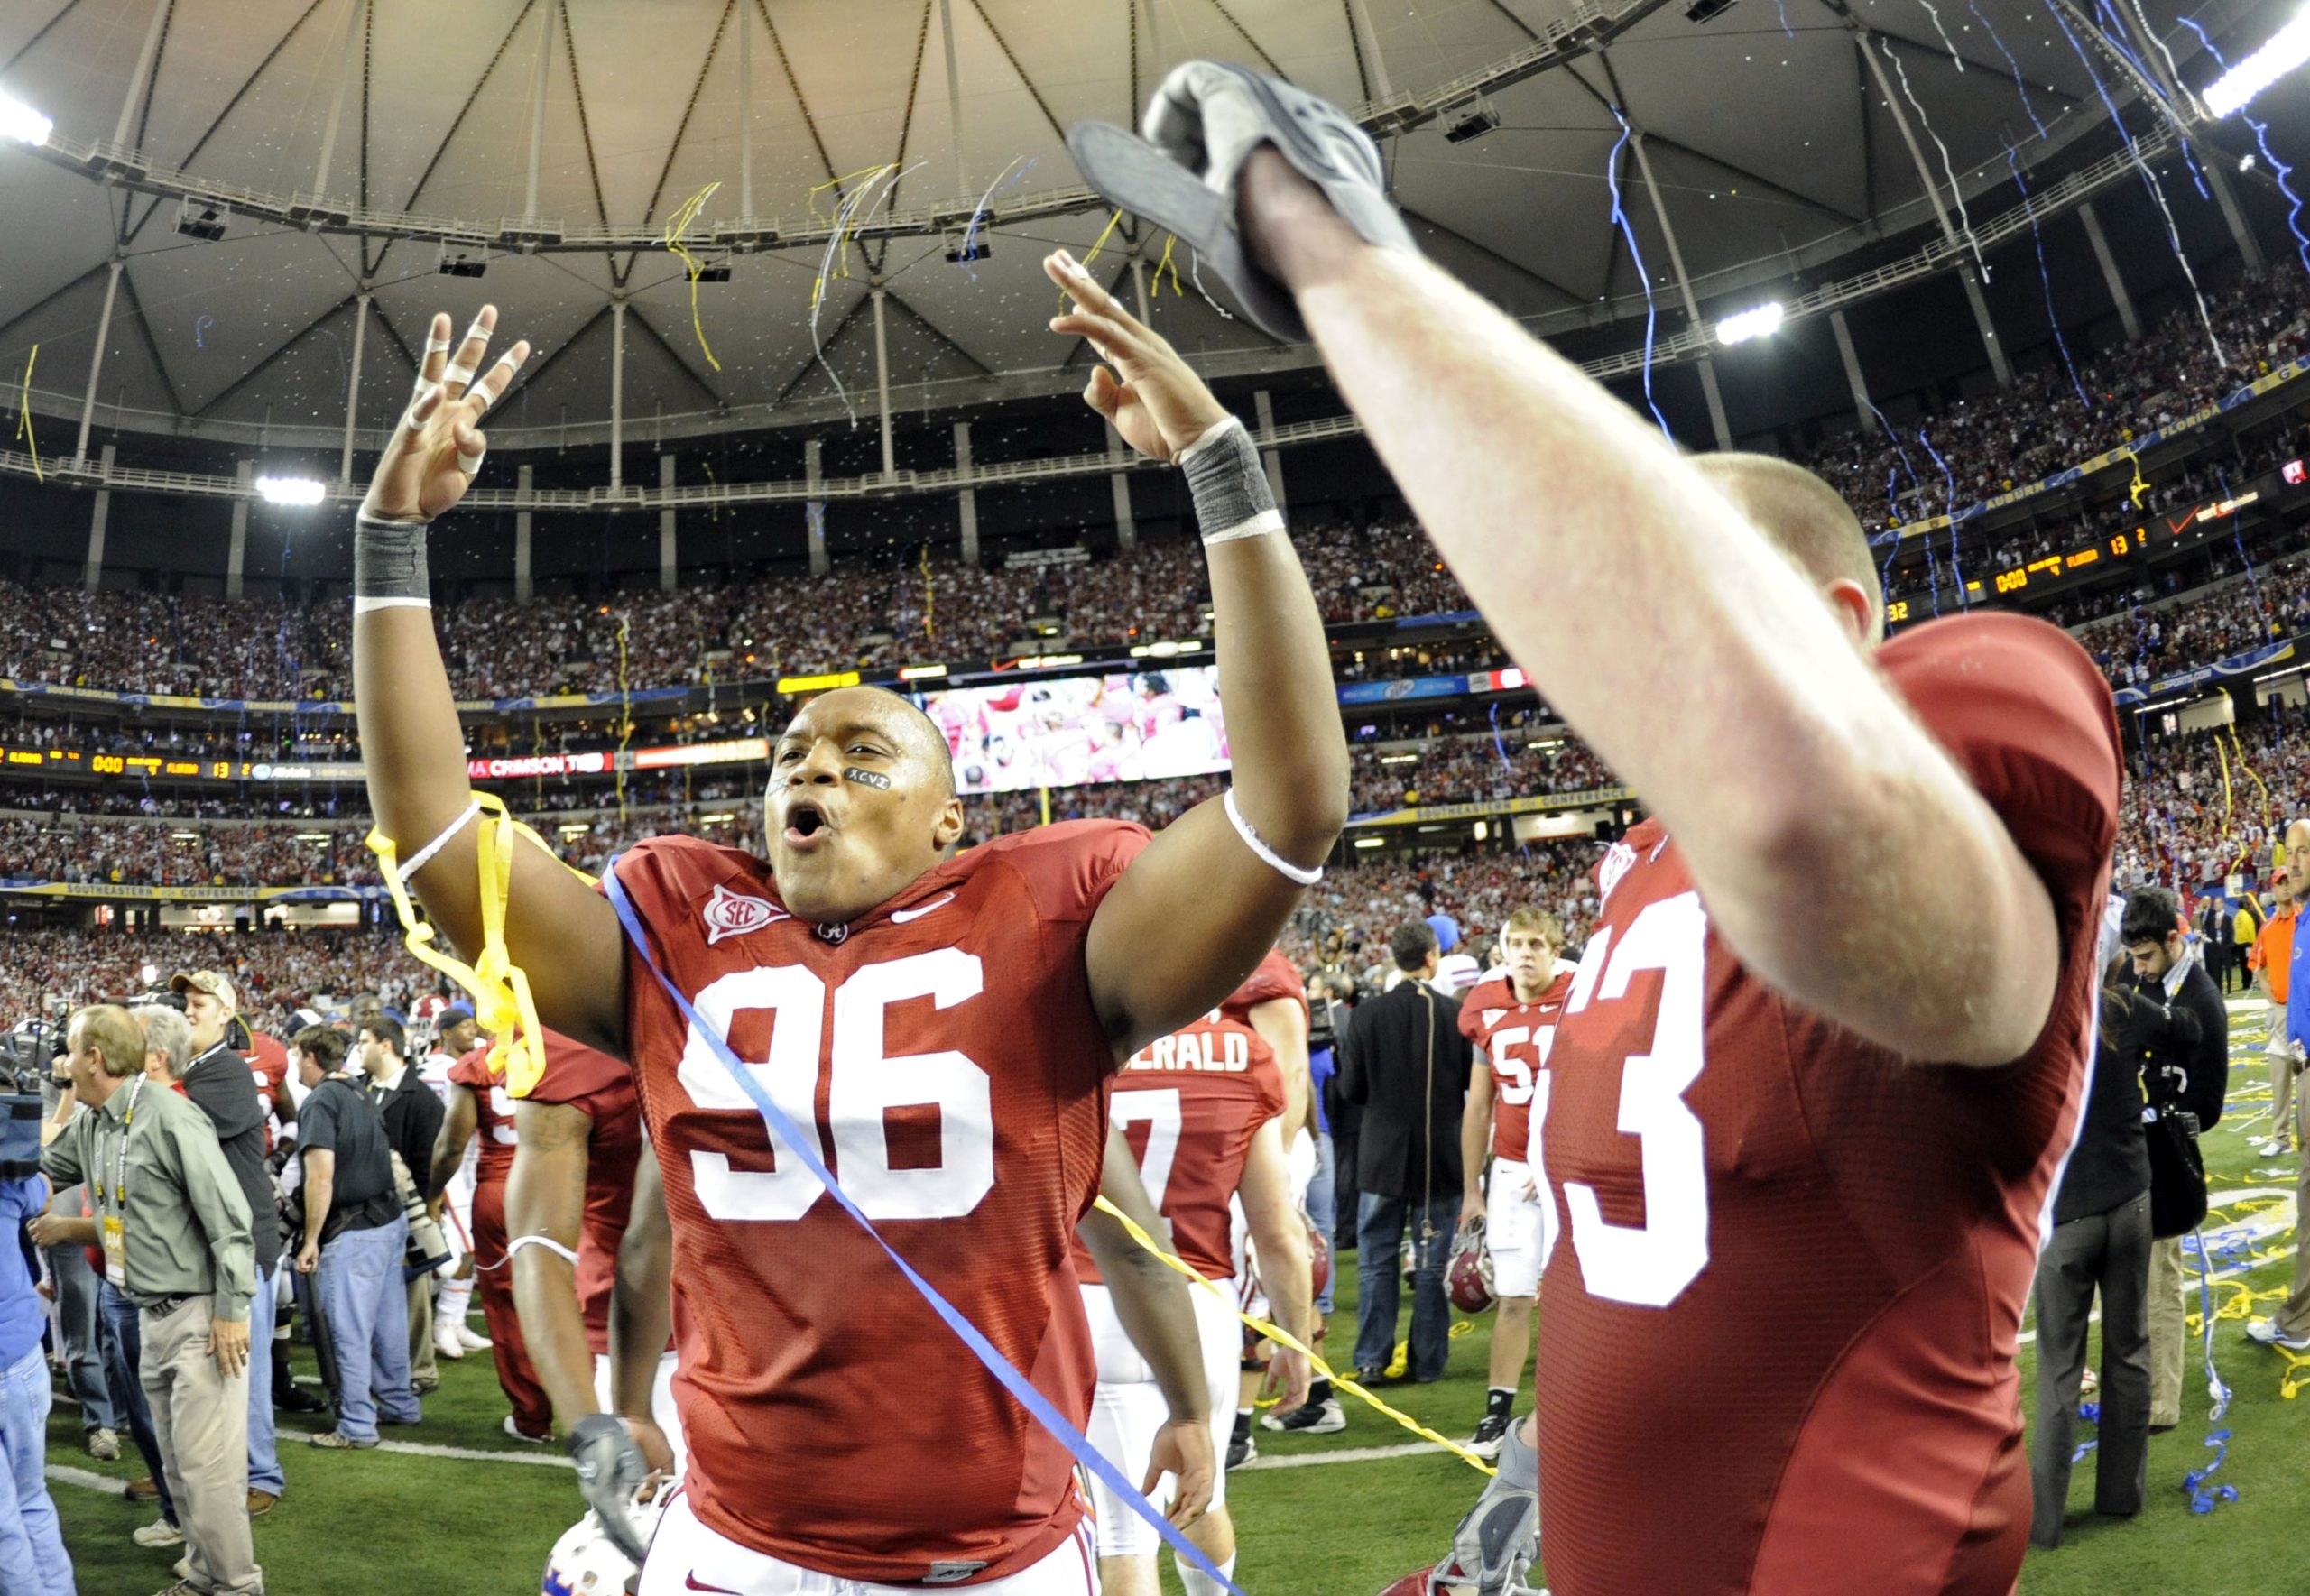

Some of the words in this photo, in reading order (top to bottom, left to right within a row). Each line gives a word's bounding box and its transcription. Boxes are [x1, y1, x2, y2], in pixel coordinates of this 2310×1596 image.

[2160, 404, 2221, 439] FLORIDA
[1986, 481, 2045, 511] AUBURN
[2136, 528, 2146, 541] 2
[2111, 535, 2128, 555] 13
[1888, 602, 1908, 622] 32
[213, 761, 230, 779] 13
[490, 757, 565, 777] CRIMSON
[849, 769, 889, 789] XCVI
[1542, 790, 1628, 807] CONFERENCE
[67, 884, 152, 897] SOUTHEASTERN
[181, 886, 259, 899] CONFERENCE
[725, 901, 756, 926] SEC
[1126, 1031, 1249, 1072] ERALD
[677, 946, 994, 1221] 96
[1528, 890, 1710, 1308] 3
